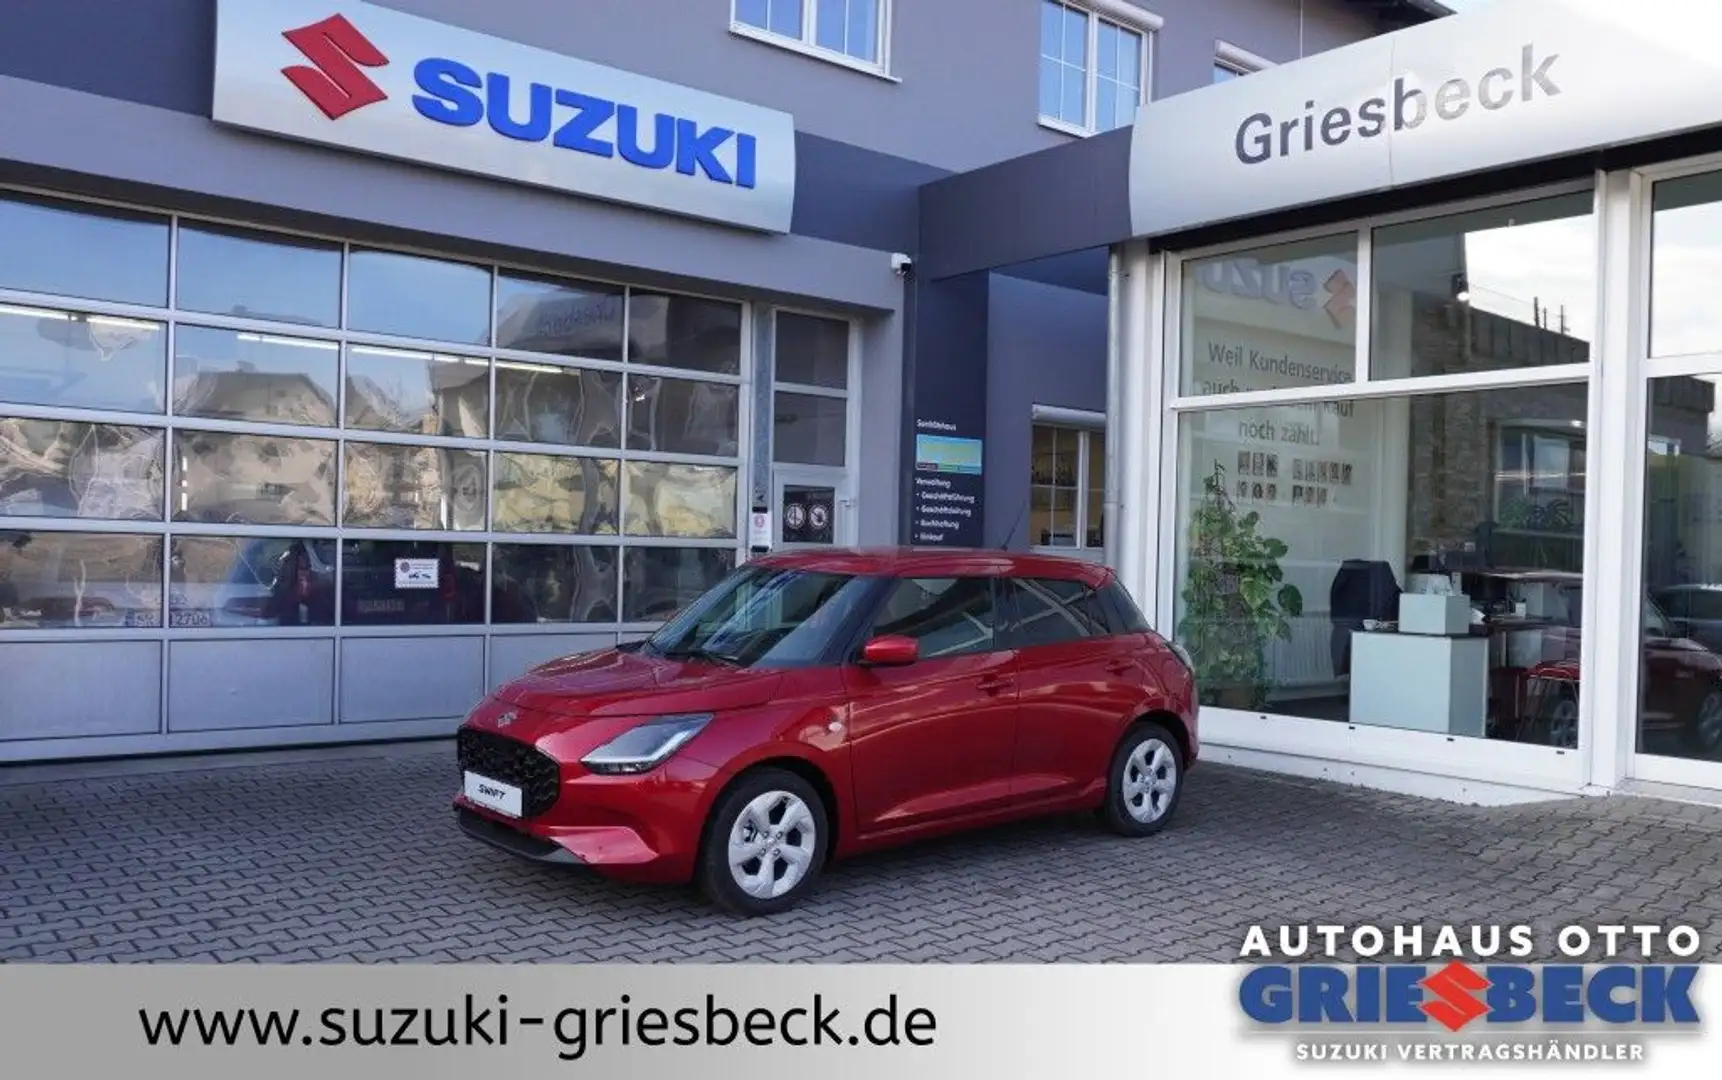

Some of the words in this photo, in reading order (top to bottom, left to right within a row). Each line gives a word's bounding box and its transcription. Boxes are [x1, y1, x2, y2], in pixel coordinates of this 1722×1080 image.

[411, 57, 757, 189] SUZUKI
[1235, 44, 1561, 165] Griesbeck
[1208, 340, 1243, 367] Weil
[1249, 350, 1353, 383] Kundenservice
[1239, 420, 1276, 441] noch
[477, 783, 507, 800] SWIFT
